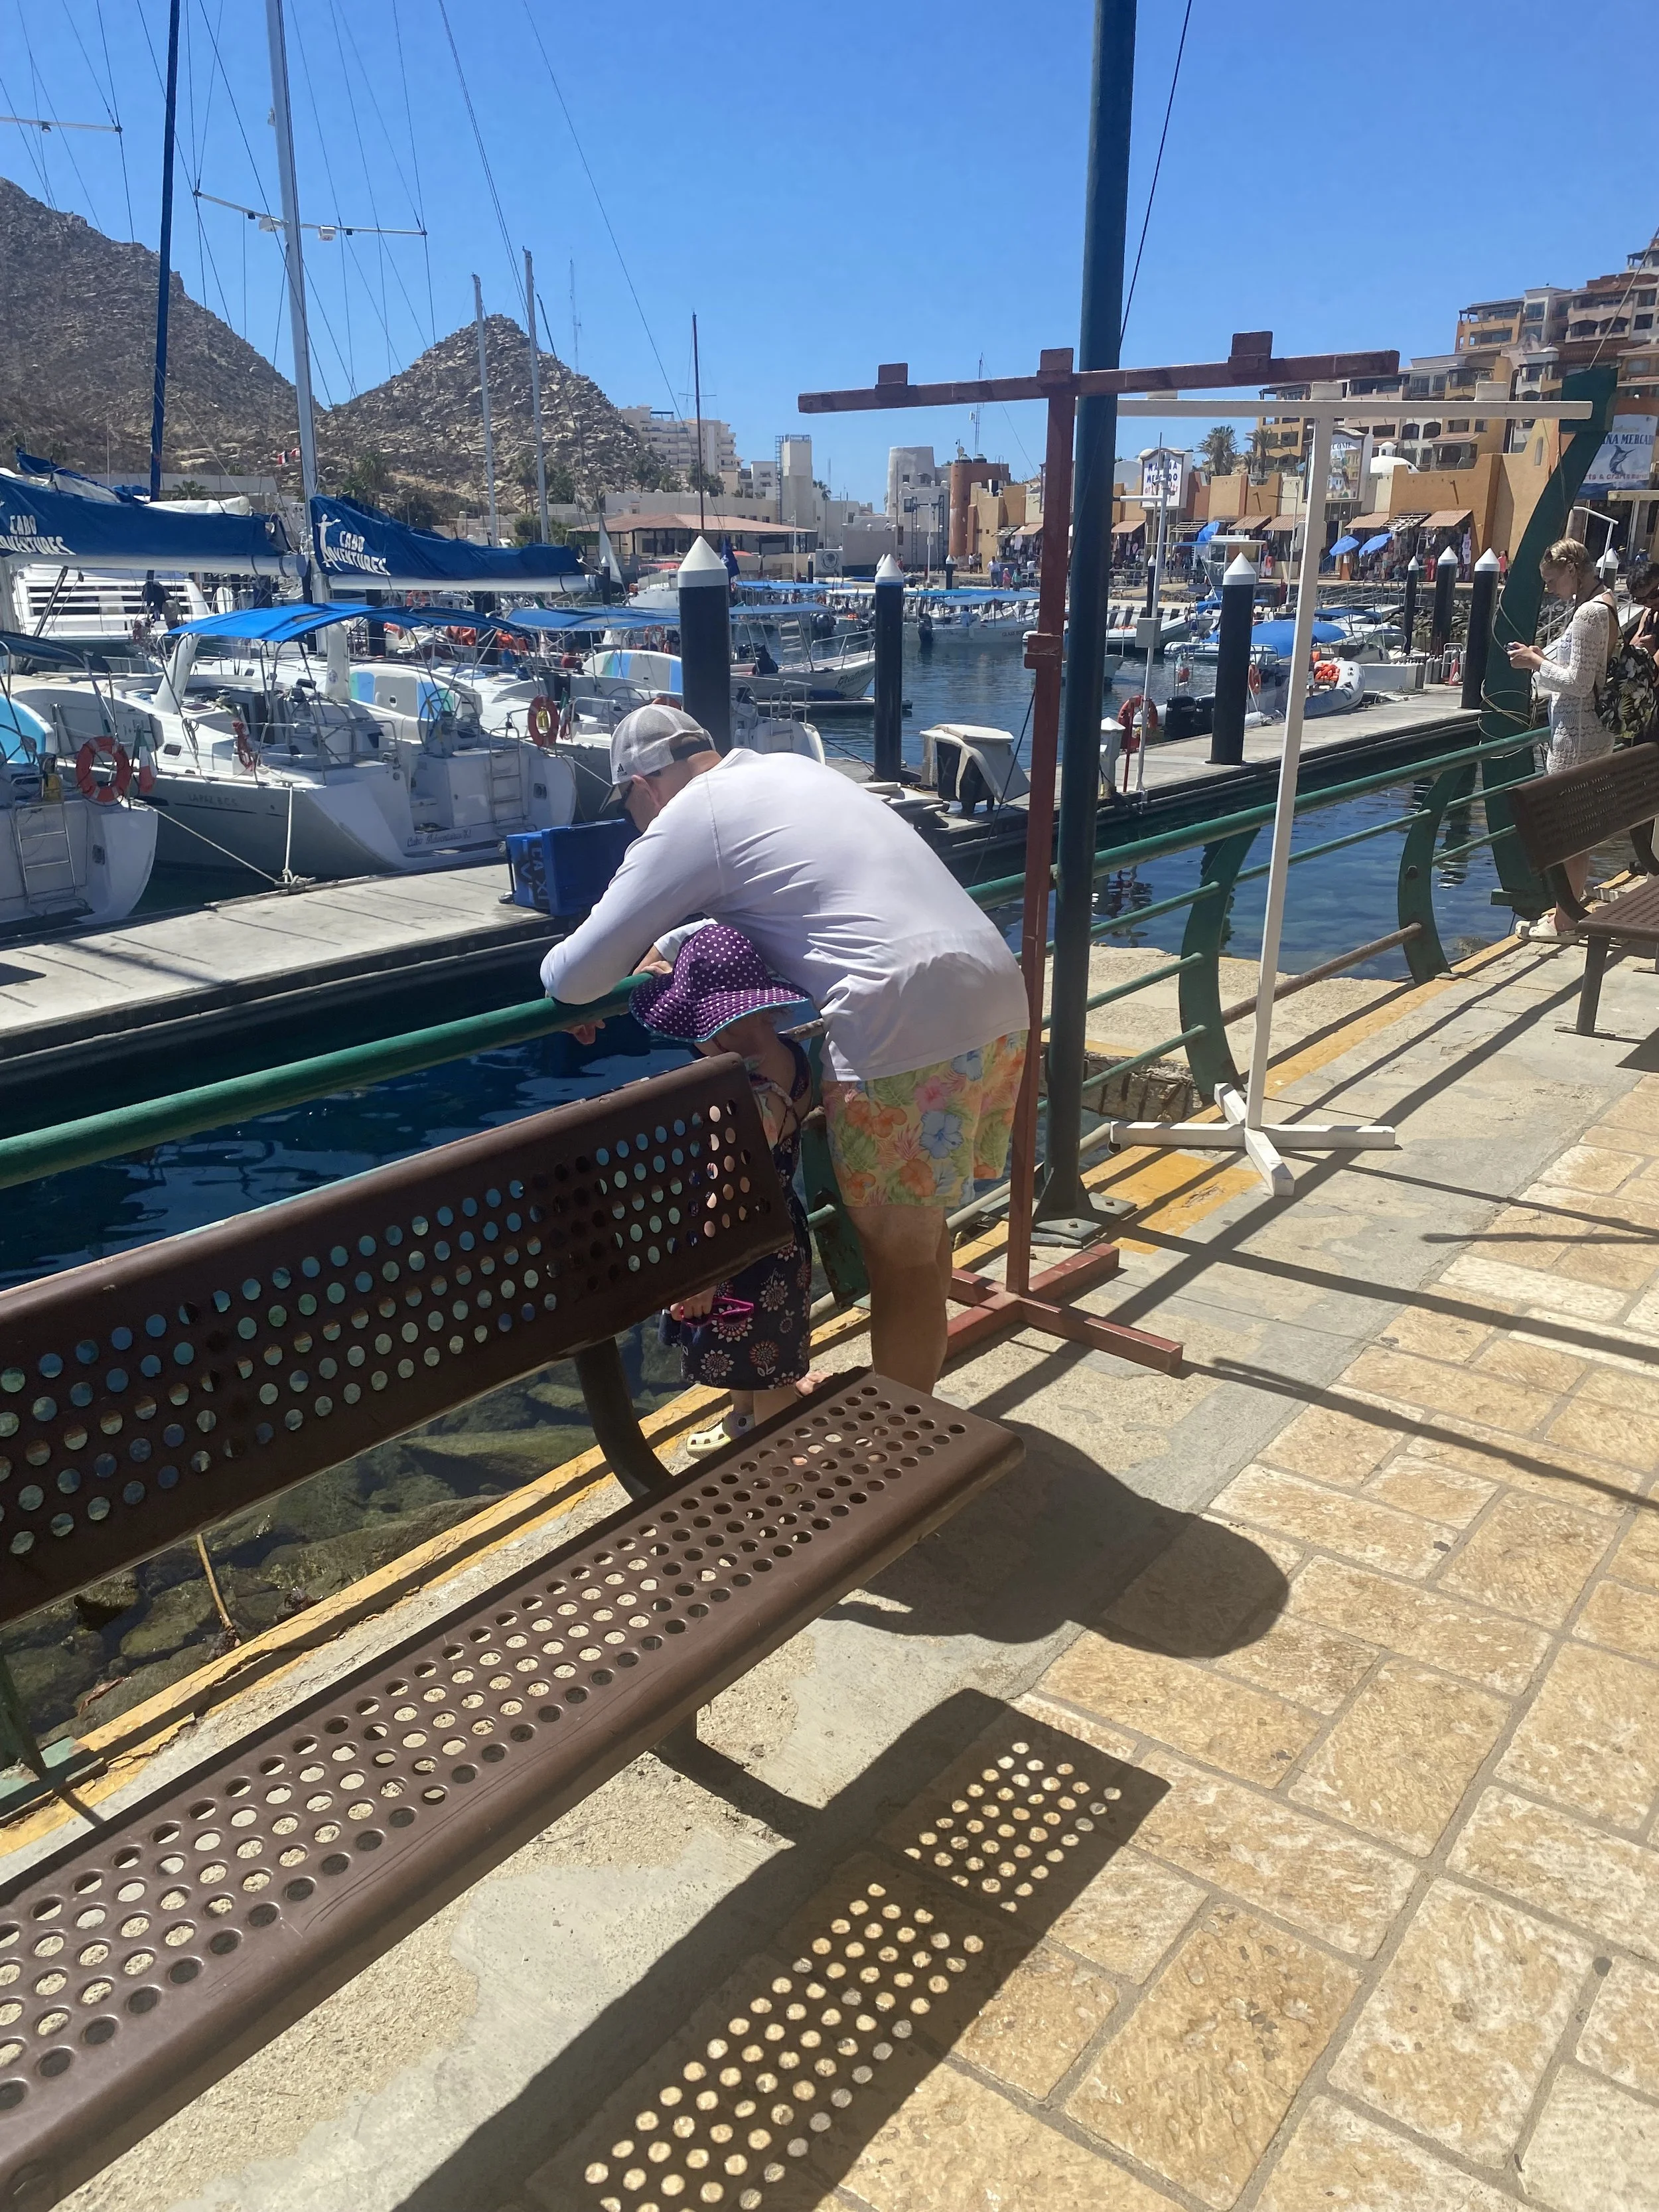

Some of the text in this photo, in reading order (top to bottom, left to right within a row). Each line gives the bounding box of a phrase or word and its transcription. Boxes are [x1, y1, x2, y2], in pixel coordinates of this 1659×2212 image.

[1332, 441, 1352, 450] COME
[9, 514, 37, 536] CABO
[0, 535, 77, 555] DVENTURES
[339, 530, 366, 553] CABO
[322, 546, 392, 577] ADVENTURES
